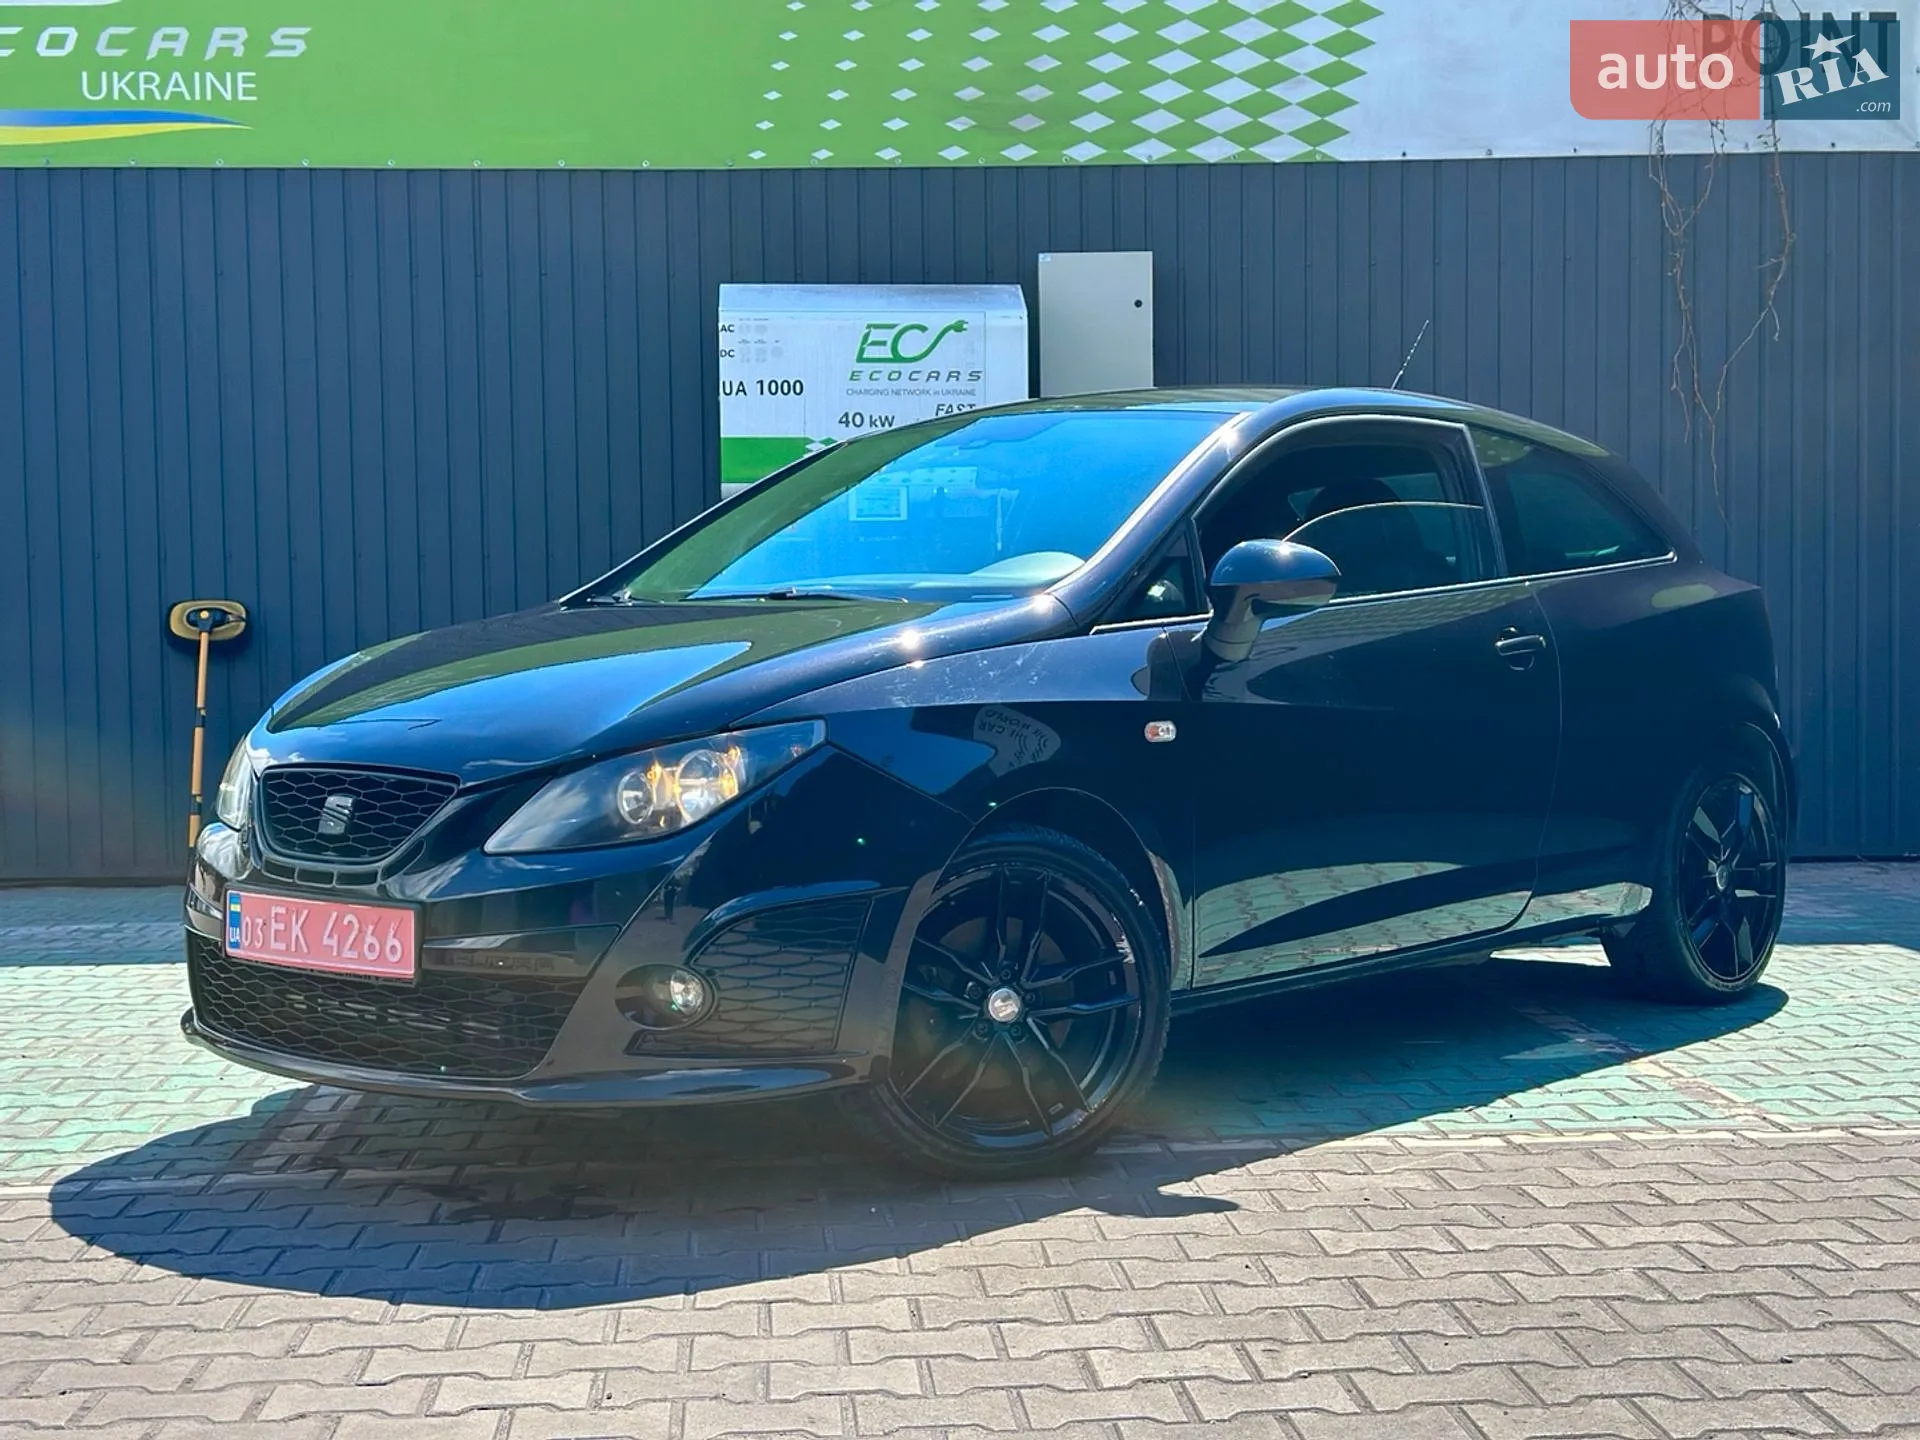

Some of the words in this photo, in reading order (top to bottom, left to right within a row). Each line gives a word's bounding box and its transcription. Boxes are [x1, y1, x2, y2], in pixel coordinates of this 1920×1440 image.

[81, 71, 257, 101] UKRAINE
[720, 324, 735, 333] AC
[720, 349, 735, 358] DC
[849, 370, 983, 382] ECOCARS
[722, 380, 747, 396] UA
[756, 379, 804, 396] 1000
[846, 388, 889, 396] CHARGING
[891, 388, 931, 396] NETWORK
[941, 388, 976, 396] UKRAINE
[838, 411, 864, 428] 40
[869, 414, 895, 428] kW
